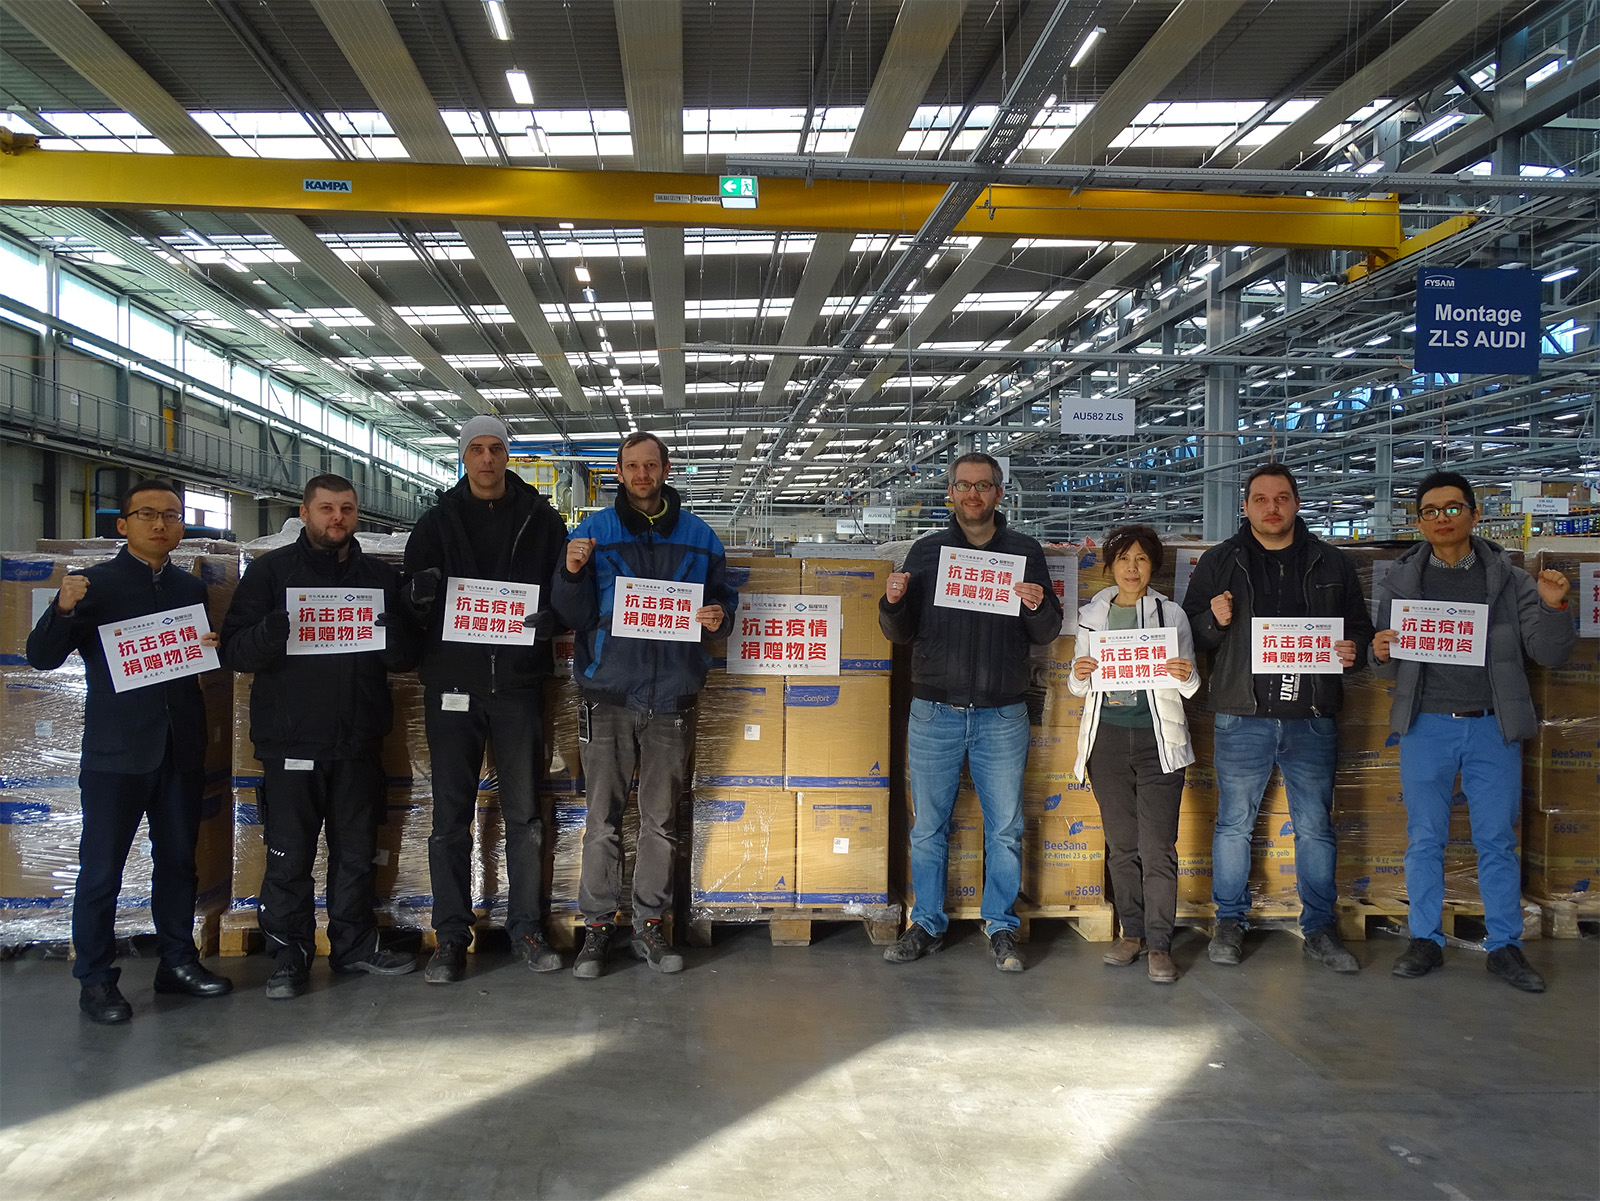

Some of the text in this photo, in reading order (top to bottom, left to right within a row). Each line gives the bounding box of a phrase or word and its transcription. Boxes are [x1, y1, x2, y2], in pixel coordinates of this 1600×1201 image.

[305, 180, 349, 191] KAMPA
[1435, 304, 1522, 326] Montage
[1428, 330, 1526, 348] ZLS AUDI
[1072, 412, 1124, 421] AU582 ZLS
[948, 565, 1013, 586] 抗击疫情
[945, 582, 1010, 603] 捐赠物资
[456, 596, 525, 616] 抗击疫情
[625, 594, 691, 612] 抗击疫情
[299, 607, 372, 622] 抗击疫情
[624, 611, 690, 630] 捐赠物资
[454, 615, 524, 634] 捐赠物资
[742, 618, 828, 637] 抗击疫情
[1402, 618, 1474, 635] 抗击疫情
[299, 626, 372, 641] 捐赠物资
[118, 626, 198, 658] 抗击疫情
[1263, 635, 1331, 649] 抗击疫情
[1400, 635, 1472, 653] 捐赠物资
[741, 641, 827, 660] 捐赠物资
[1100, 646, 1166, 662] 抗击疫情
[1263, 652, 1330, 663] 捐赠物资
[122, 644, 203, 676] 捐赠物资
[1101, 663, 1168, 679] 捐赠物资
[1551, 748, 1592, 758] BeeSana
[1553, 823, 1579, 834] 3699
[1044, 841, 1087, 850] BeeSana
[1089, 852, 1101, 860] gelb
[1277, 850, 1289, 858] gelb
[1178, 868, 1212, 877] BeeSan
[1375, 866, 1404, 876] eSana
[1075, 885, 1101, 896] 3699
